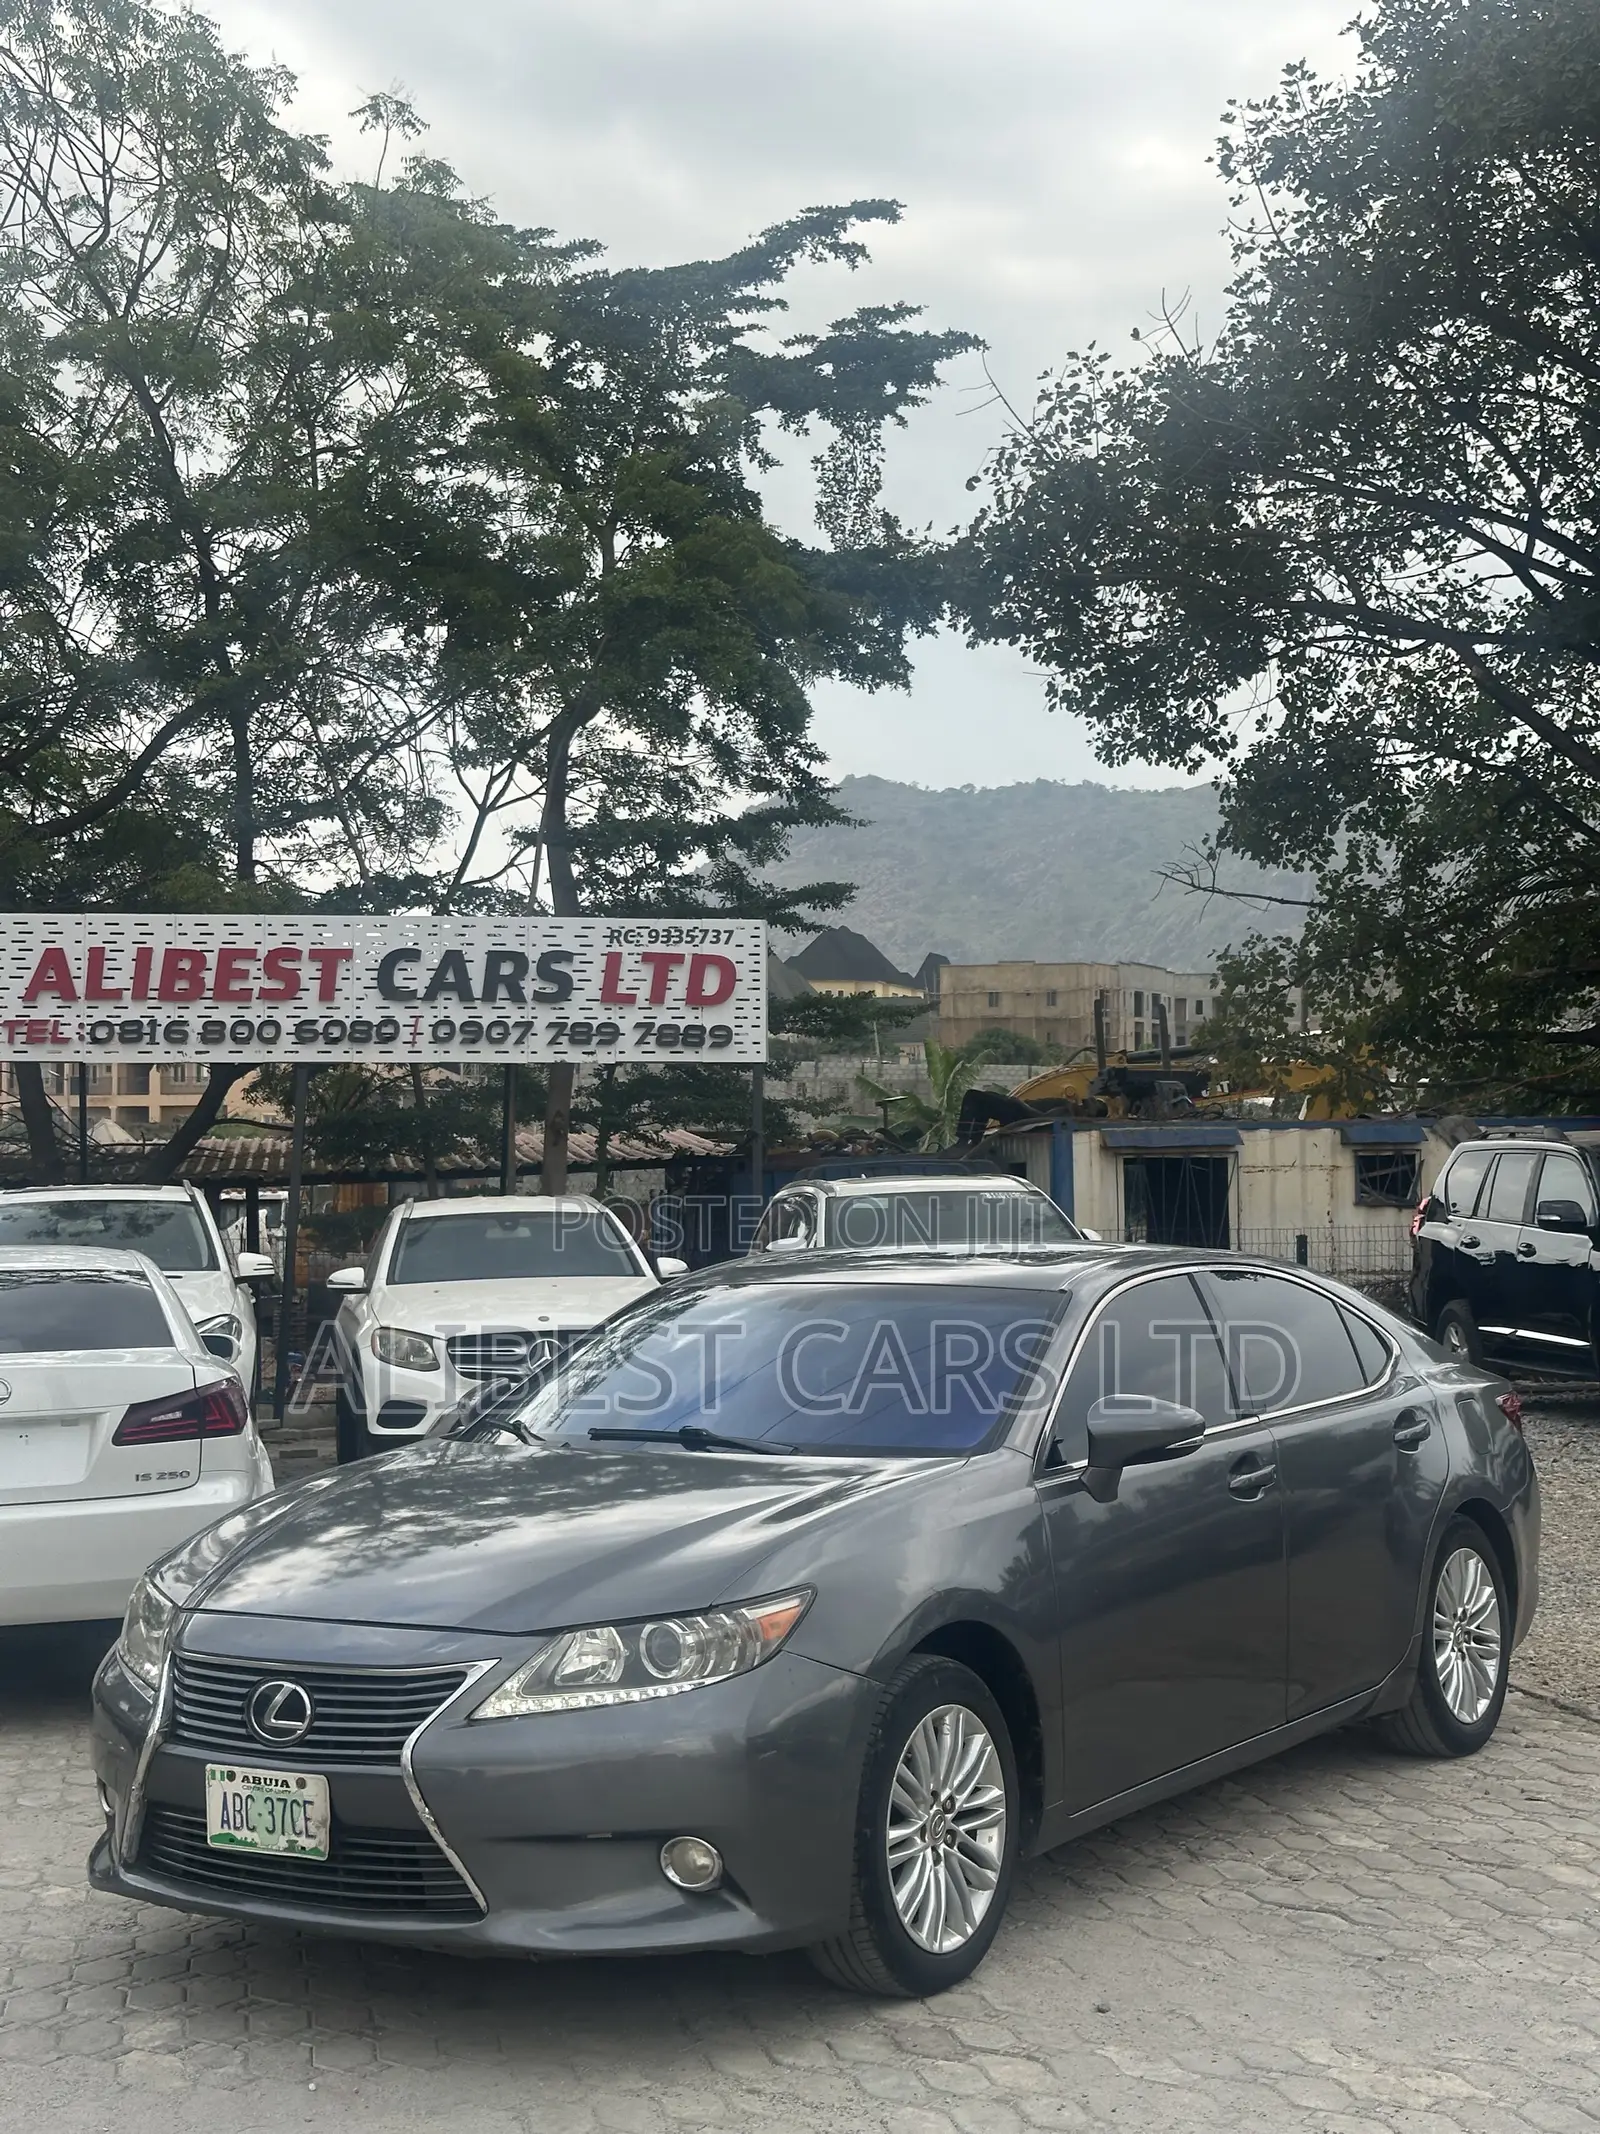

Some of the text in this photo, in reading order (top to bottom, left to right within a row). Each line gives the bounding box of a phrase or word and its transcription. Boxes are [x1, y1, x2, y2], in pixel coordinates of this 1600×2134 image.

[647, 928, 735, 946] 9335737
[22, 946, 738, 1007] ALIBEST CARS LTD
[200, 1019, 282, 1045] 800
[294, 1018, 401, 1045] 6080
[431, 1018, 535, 1046] 0907
[545, 1021, 621, 1047] 789
[632, 1021, 734, 1049] 7889
[135, 1470, 190, 1482] IS 250
[241, 1774, 291, 1789] ABUJA
